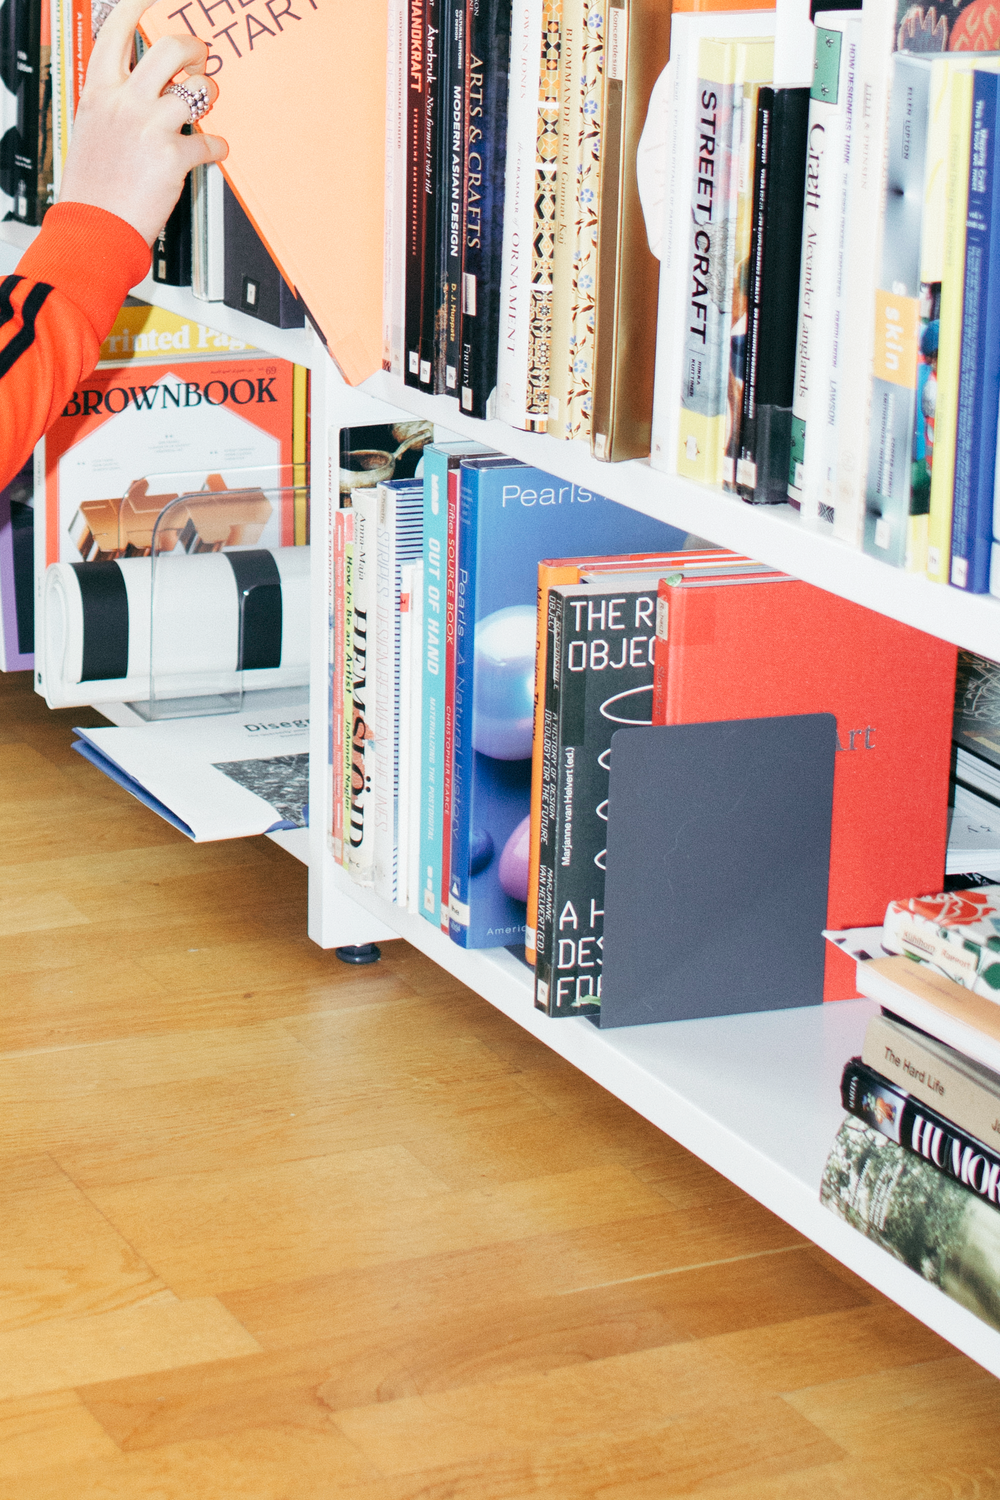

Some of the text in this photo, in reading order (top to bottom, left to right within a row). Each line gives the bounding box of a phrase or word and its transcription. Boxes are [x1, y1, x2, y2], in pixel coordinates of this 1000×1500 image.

[426, 23, 439, 84] Återbruk
[611, 9, 620, 79] Koncertdesign
[466, 53, 484, 250] ARTS & CRAFTS
[558, 27, 574, 220] BLOMMANDE RUM Gunnar
[842, 42, 856, 166] HOW DESIGNERS THINK
[903, 86, 914, 161] ELLEN LUPTON
[449, 85, 462, 258] MODERN ASIAN DESIGN
[690, 88, 717, 344] STREET CRAFT
[506, 232, 522, 356] ORNAMENT
[798, 225, 818, 399] Alexander Langlands
[884, 305, 905, 371] skin
[60, 377, 278, 417] BROWNBOOK
[827, 380, 838, 427] LAWSON
[426, 536, 441, 676] OUT OF HAND
[446, 501, 456, 646] Fifties SOURCE BOOK
[547, 594, 557, 634] OBJECT
[568, 597, 627, 632] THE
[345, 555, 354, 694] How Artist
[443, 777, 452, 816] PEARCE
[450, 675, 466, 839] Natural History
[541, 708, 553, 846] IDEOLOGY THE FUTURE
[549, 722, 559, 821] HISTORY DESIGN
[561, 747, 576, 867] Marjanne van Helvert (ed.)
[537, 864, 548, 931] VAN HELVERT
[545, 866, 554, 924] MARJANNE
[559, 900, 579, 931] A
[884, 1045, 946, 1097] The Hard Life
